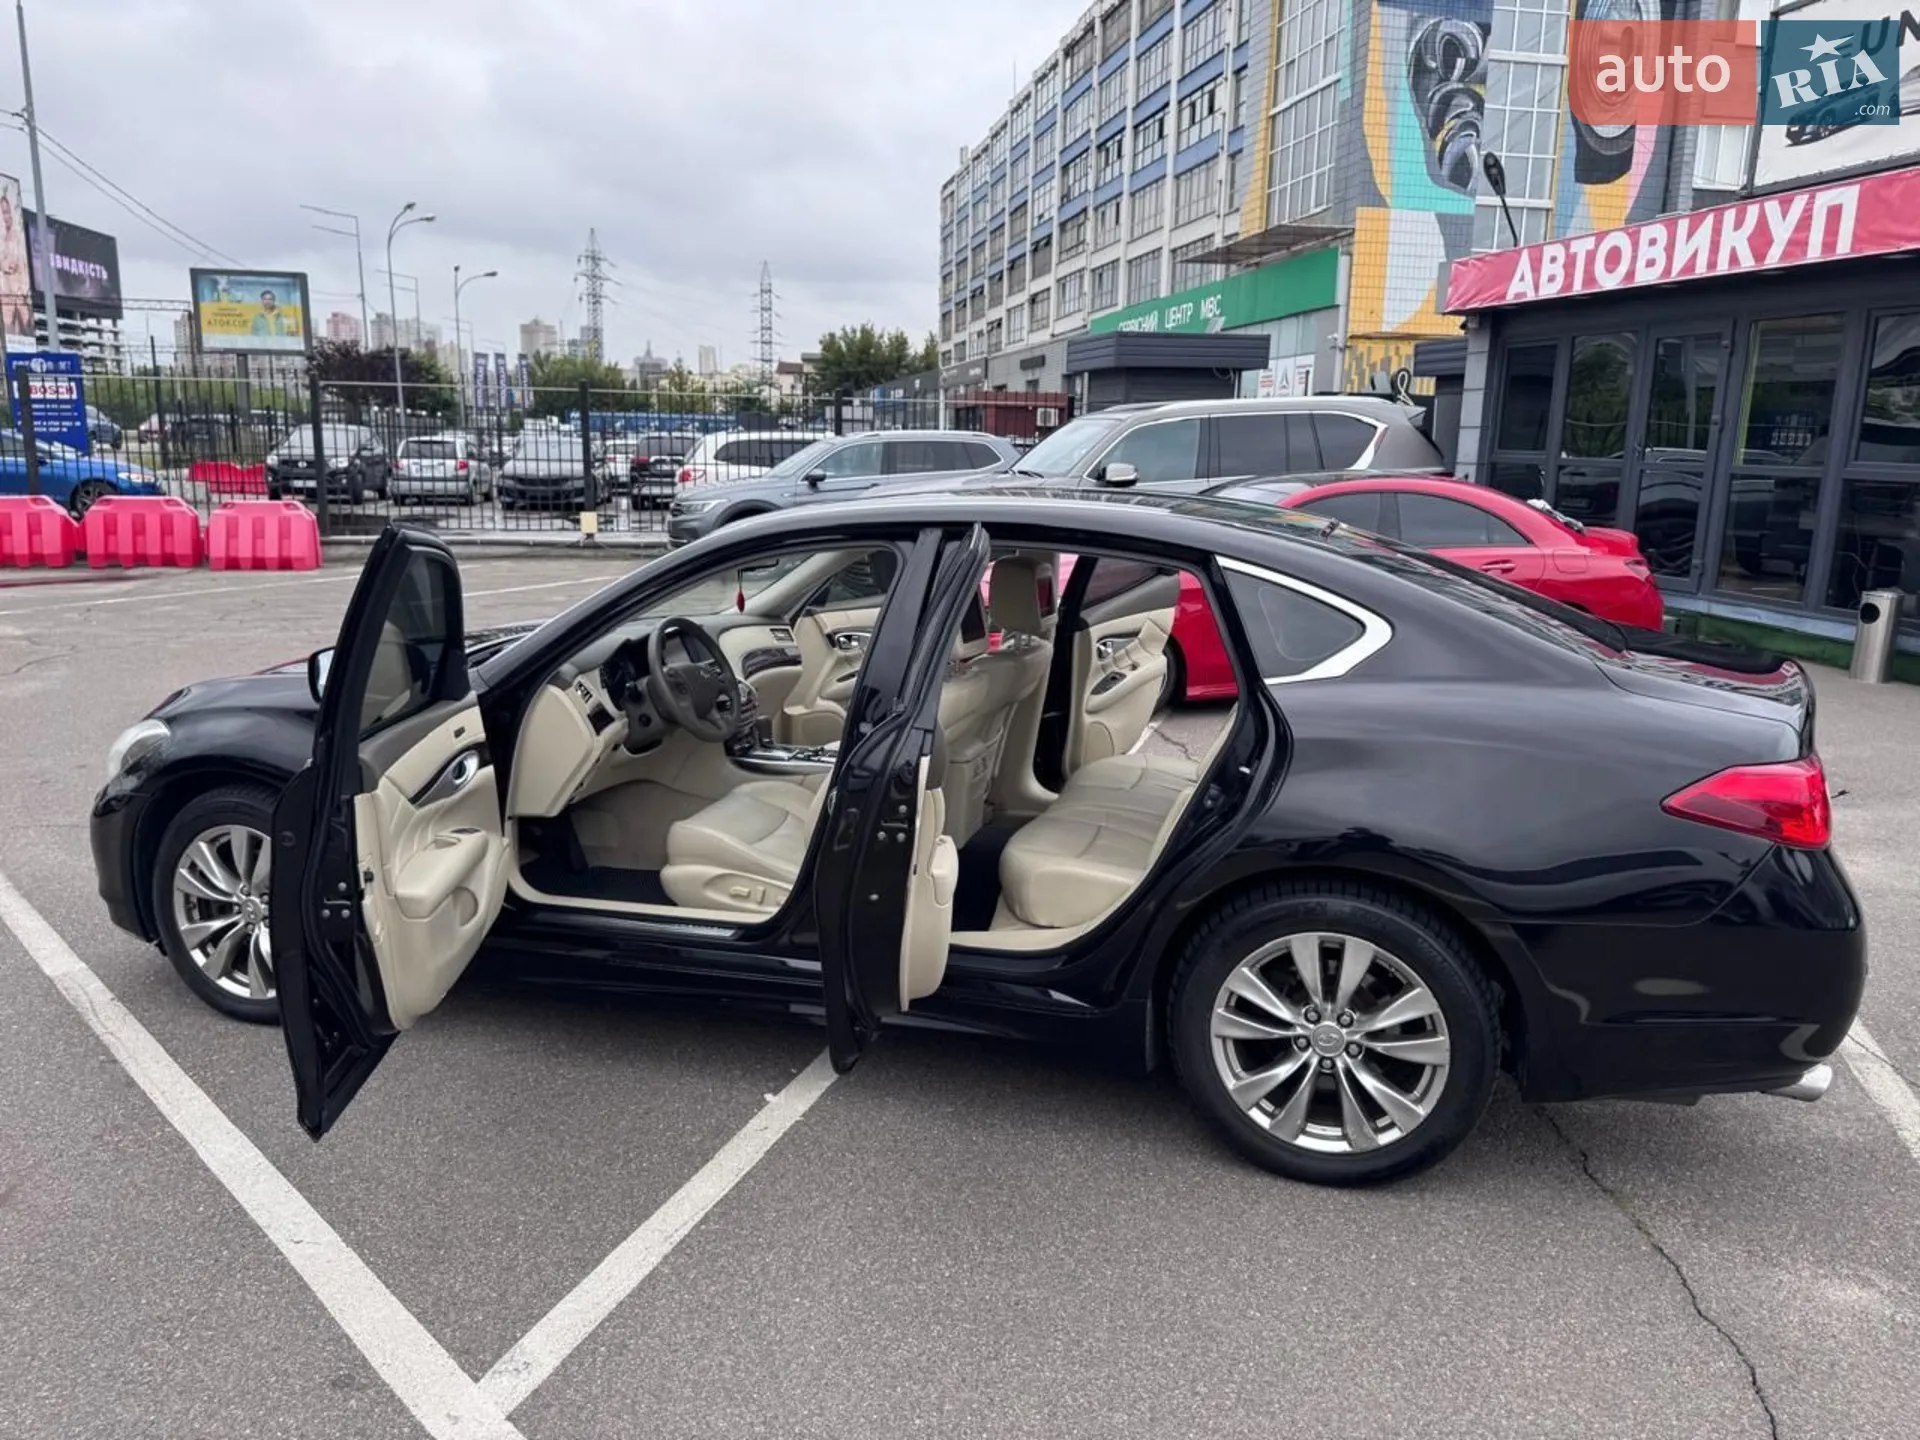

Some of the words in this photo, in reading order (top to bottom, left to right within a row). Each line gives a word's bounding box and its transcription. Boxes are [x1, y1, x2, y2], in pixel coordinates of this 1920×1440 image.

[1506, 184, 1861, 301] АВТОВИКУП
[1164, 302, 1194, 330] ЦЕНТР
[1200, 294, 1222, 320] МВС
[30, 384, 73, 395] BOSCH
